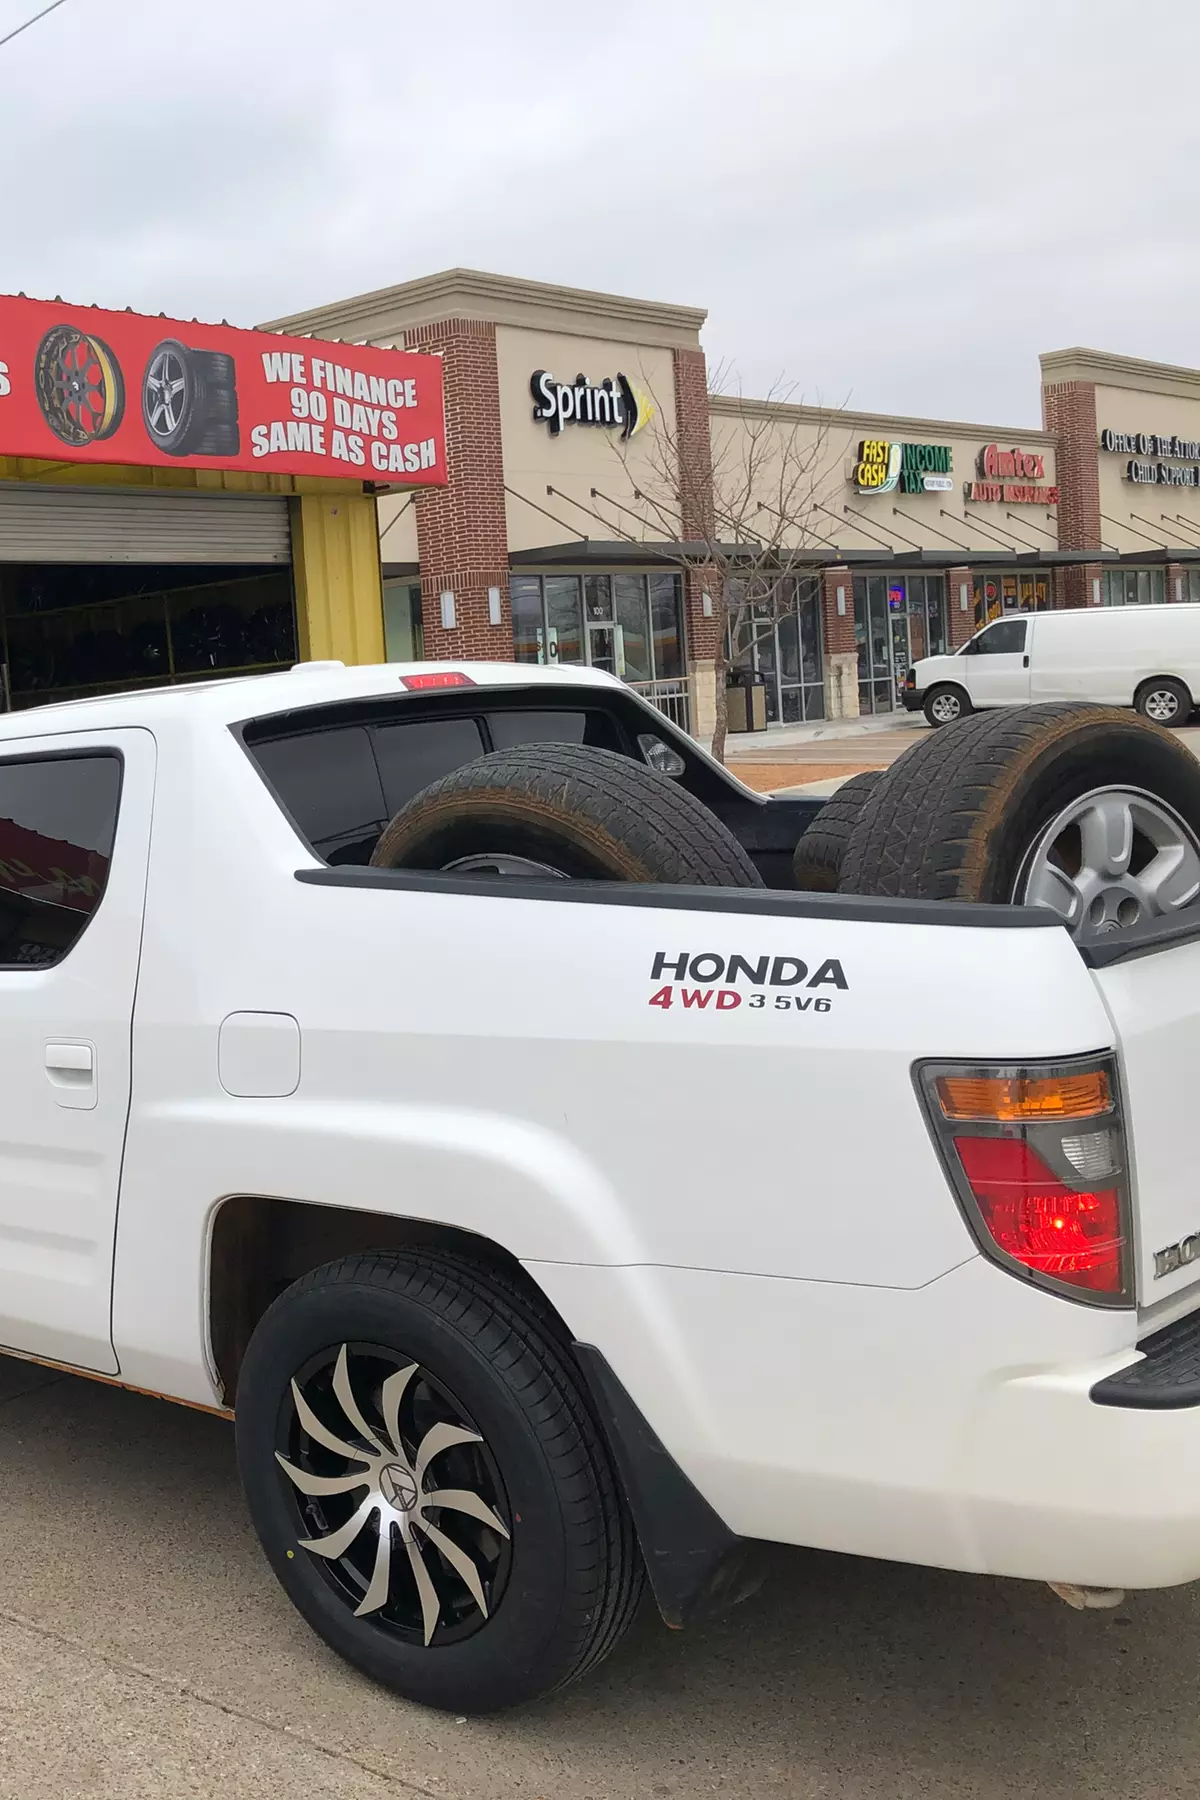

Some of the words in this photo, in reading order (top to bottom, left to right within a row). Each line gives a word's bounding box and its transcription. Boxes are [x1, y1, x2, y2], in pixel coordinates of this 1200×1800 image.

[261, 352, 308, 384] WE
[311, 357, 418, 408] FINANCE
[290, 387, 327, 422] 90
[333, 397, 399, 440] DAYS
[538, 372, 624, 432] Sprint
[251, 421, 327, 458] SAME
[331, 429, 366, 466] AS
[370, 438, 437, 473] CASH
[862, 440, 890, 463] FAST
[901, 443, 953, 473] INCOME
[983, 444, 1045, 479] Amtex
[857, 463, 886, 486] CASH
[902, 470, 924, 493] TAX
[970, 482, 1001, 502] AUTO
[650, 951, 850, 990] HONDA
[648, 985, 743, 1011] 4WD
[1152, 1231, 1200, 1280] HO
